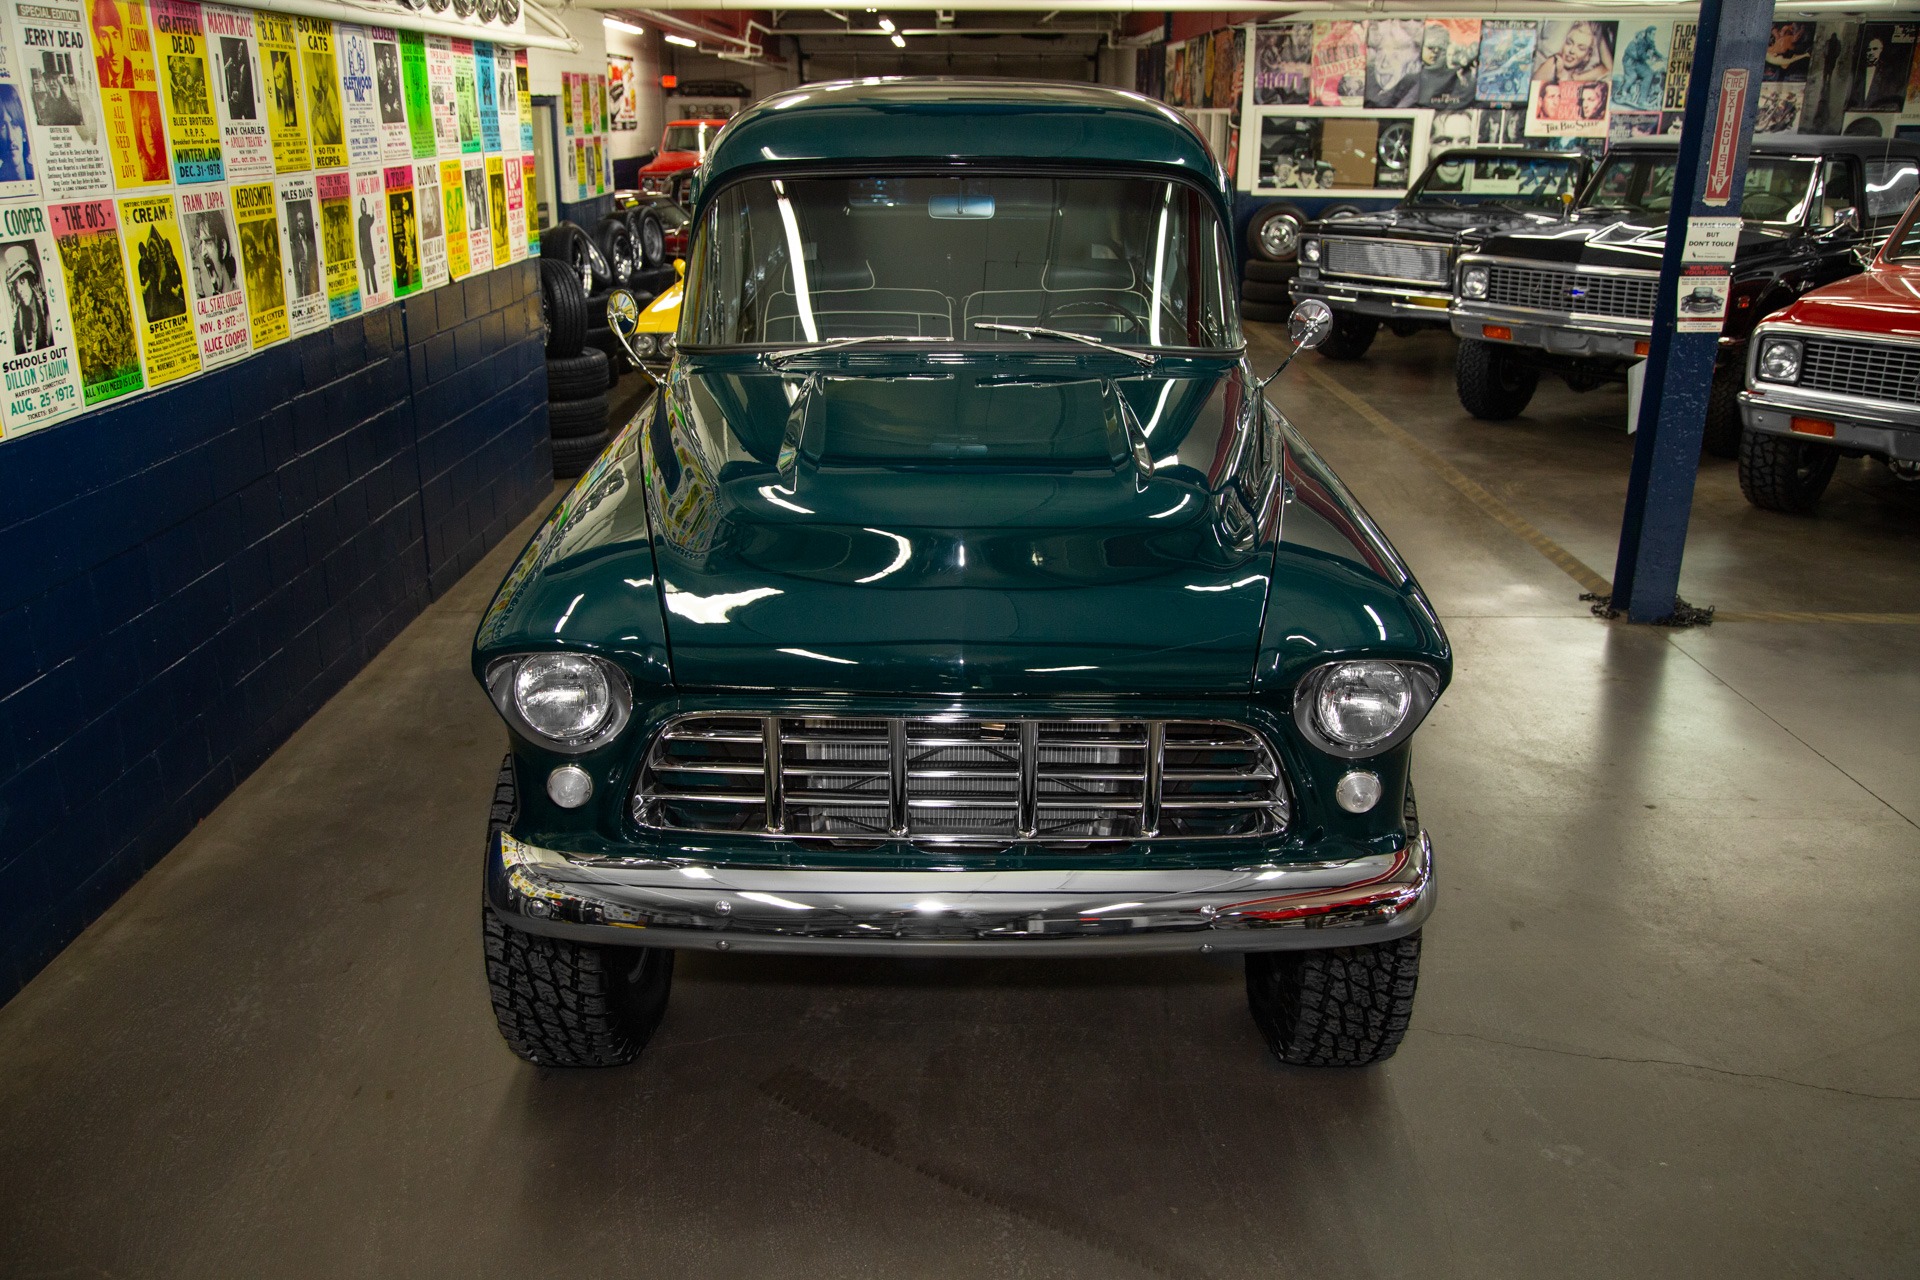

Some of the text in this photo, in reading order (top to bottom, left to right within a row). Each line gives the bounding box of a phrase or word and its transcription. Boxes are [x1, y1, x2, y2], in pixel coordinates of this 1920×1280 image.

[20, 5, 78, 21] SPECIAL EDITION
[266, 14, 290, 23] PERSON
[158, 14, 202, 36] GRATEFUL
[206, 12, 254, 38] MARVIN GAYE
[280, 22, 294, 43] KING
[297, 17, 332, 36] SO MANY
[1675, 24, 1696, 37] FLOA
[24, 28, 84, 48] JERRY DEAD
[127, 28, 151, 52] LENNON
[372, 26, 396, 42] QUEEN
[172, 35, 196, 54] DEAD
[308, 35, 328, 52] CATS
[1673, 37, 1692, 50] LIKE
[1316, 58, 1366, 78] MADNESS
[1670, 62, 1690, 74] STIN
[343, 76, 372, 90] FLEETWOOD
[1668, 74, 1687, 86] LIKE
[1726, 78, 1744, 88] FIRE
[354, 88, 366, 102] MAC
[1665, 88, 1686, 108] BE
[114, 106, 124, 119] ALL
[172, 116, 214, 126] BLUES BROTHERS
[114, 121, 126, 134] YOU
[226, 126, 265, 136] RAY CHARLES
[115, 136, 130, 148] NEED
[122, 150, 130, 163] IS
[176, 147, 220, 164] WINTERLAND
[316, 156, 340, 166] RECIPES
[121, 165, 136, 178] LOVE
[180, 166, 196, 178] DEC.
[196, 164, 220, 176] 31-1978
[386, 171, 405, 188] A TRIP
[334, 176, 342, 186] WHO
[182, 191, 225, 212] FRANK ZAPPA
[236, 186, 272, 209] AEROSMITH
[281, 188, 314, 200] MILES DAVIS
[4, 206, 46, 237] COOPER
[62, 203, 106, 230] THE 60'S
[132, 205, 168, 224] CREAM
[326, 264, 340, 276] EMPIRE
[340, 260, 356, 271] THEATRE
[198, 291, 243, 316] CAL. STATE COLLEGE
[150, 315, 188, 334] SPECTRUM
[200, 321, 216, 334] NOV.
[218, 315, 236, 330] 8-1972
[254, 316, 266, 326] CIVIC
[266, 310, 284, 321] CENTER
[204, 336, 224, 354] ALICE
[224, 328, 248, 348] COOPER
[2, 347, 68, 373] SCHOOLS OUT
[5, 358, 70, 391] DILLON STADIUM
[42, 378, 67, 390] CONNECTICUT
[85, 374, 142, 399] ALL YOU NEED IS LOVE
[11, 384, 76, 416] AUG. 25-1972
